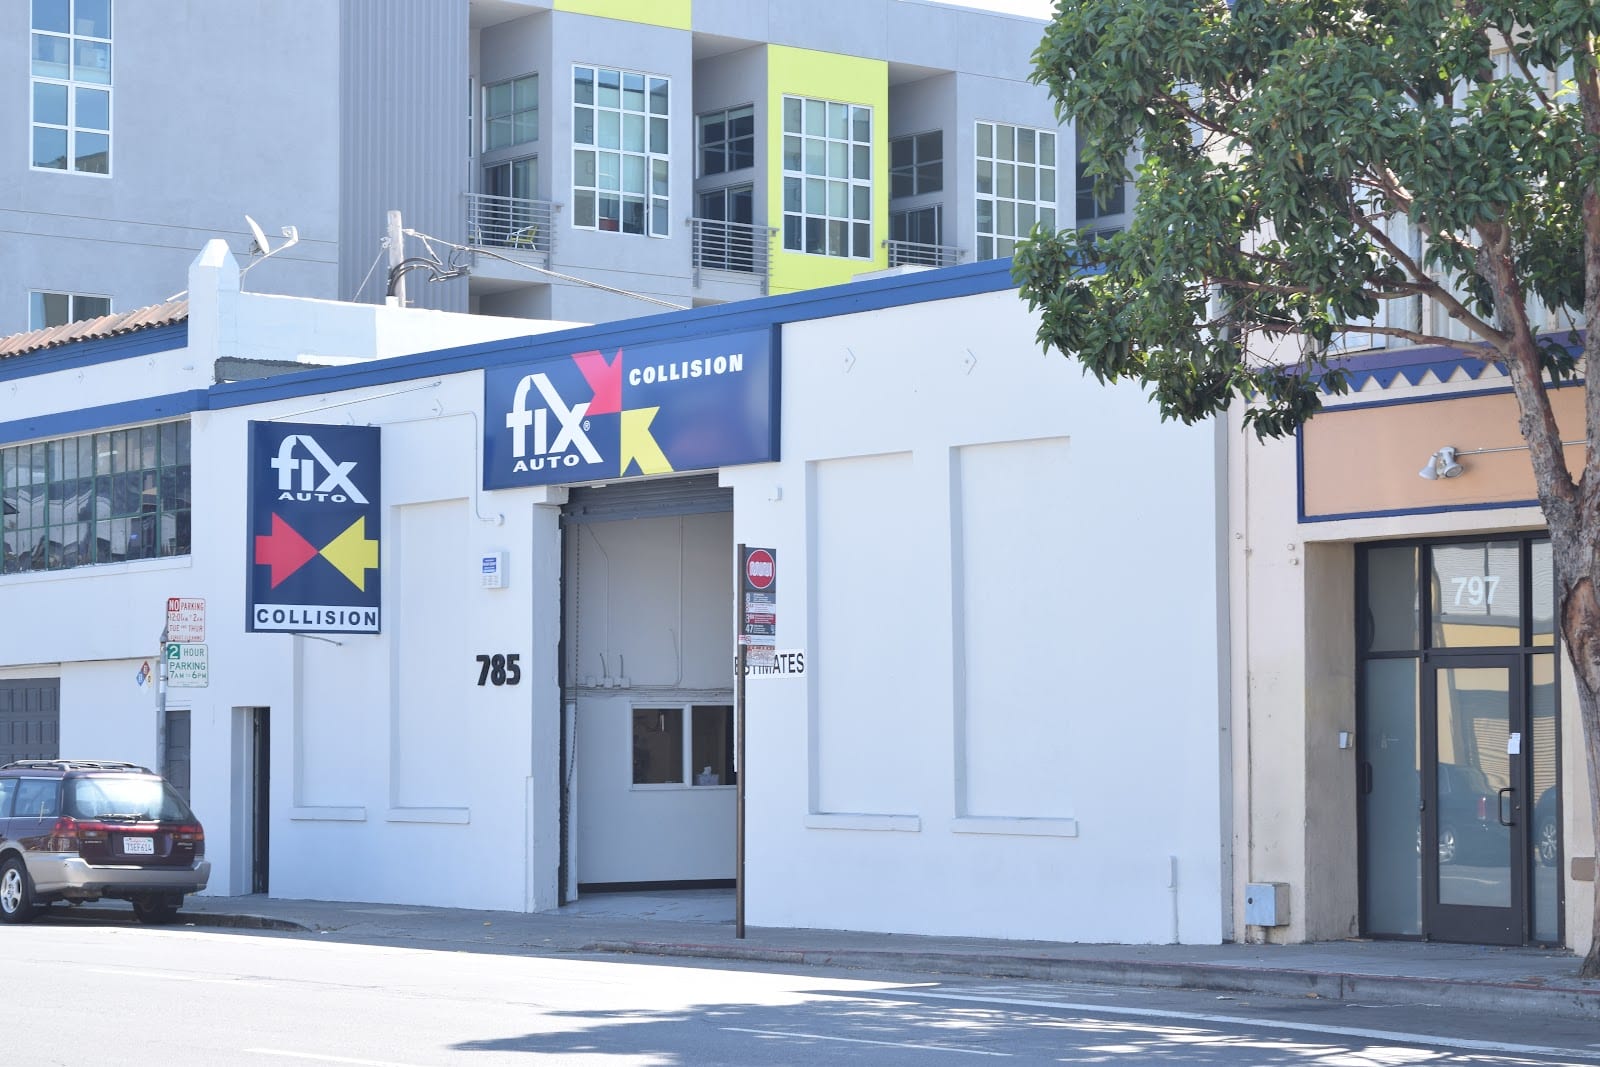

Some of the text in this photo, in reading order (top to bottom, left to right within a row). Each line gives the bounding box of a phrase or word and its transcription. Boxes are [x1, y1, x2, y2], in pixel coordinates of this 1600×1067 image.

[629, 353, 743, 386] COLLISION
[513, 454, 580, 473] AUTO
[278, 491, 347, 503] AUTO
[1451, 575, 1500, 606] 797
[169, 599, 204, 611] NO PARKING
[256, 608, 376, 626] COLLISION
[745, 624, 754, 634] 47
[169, 645, 205, 659] 2 HOUR
[169, 661, 206, 671] PARKING
[476, 653, 521, 686] 785
